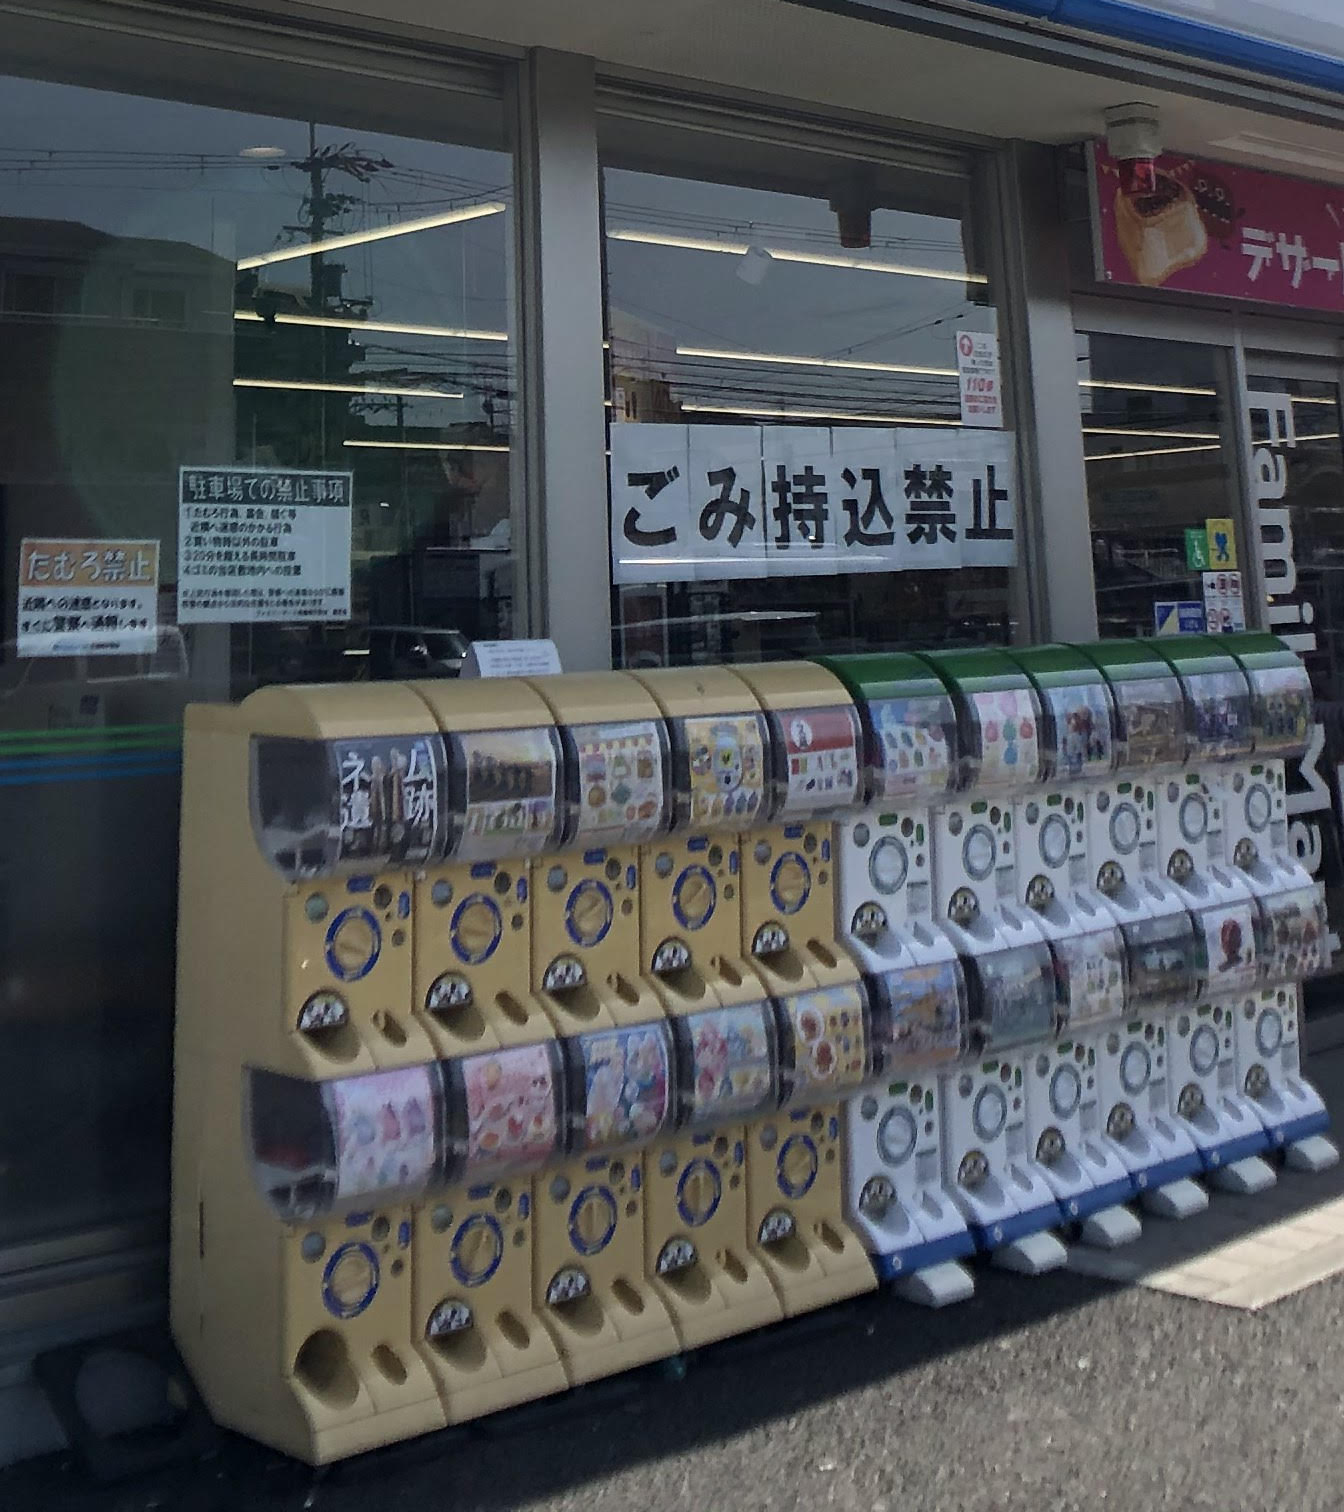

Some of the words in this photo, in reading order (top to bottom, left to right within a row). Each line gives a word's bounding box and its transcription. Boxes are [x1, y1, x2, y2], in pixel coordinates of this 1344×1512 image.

[623, 464, 1015, 550] ごみ持込禁止
[27, 548, 152, 582] たむろ禁止
